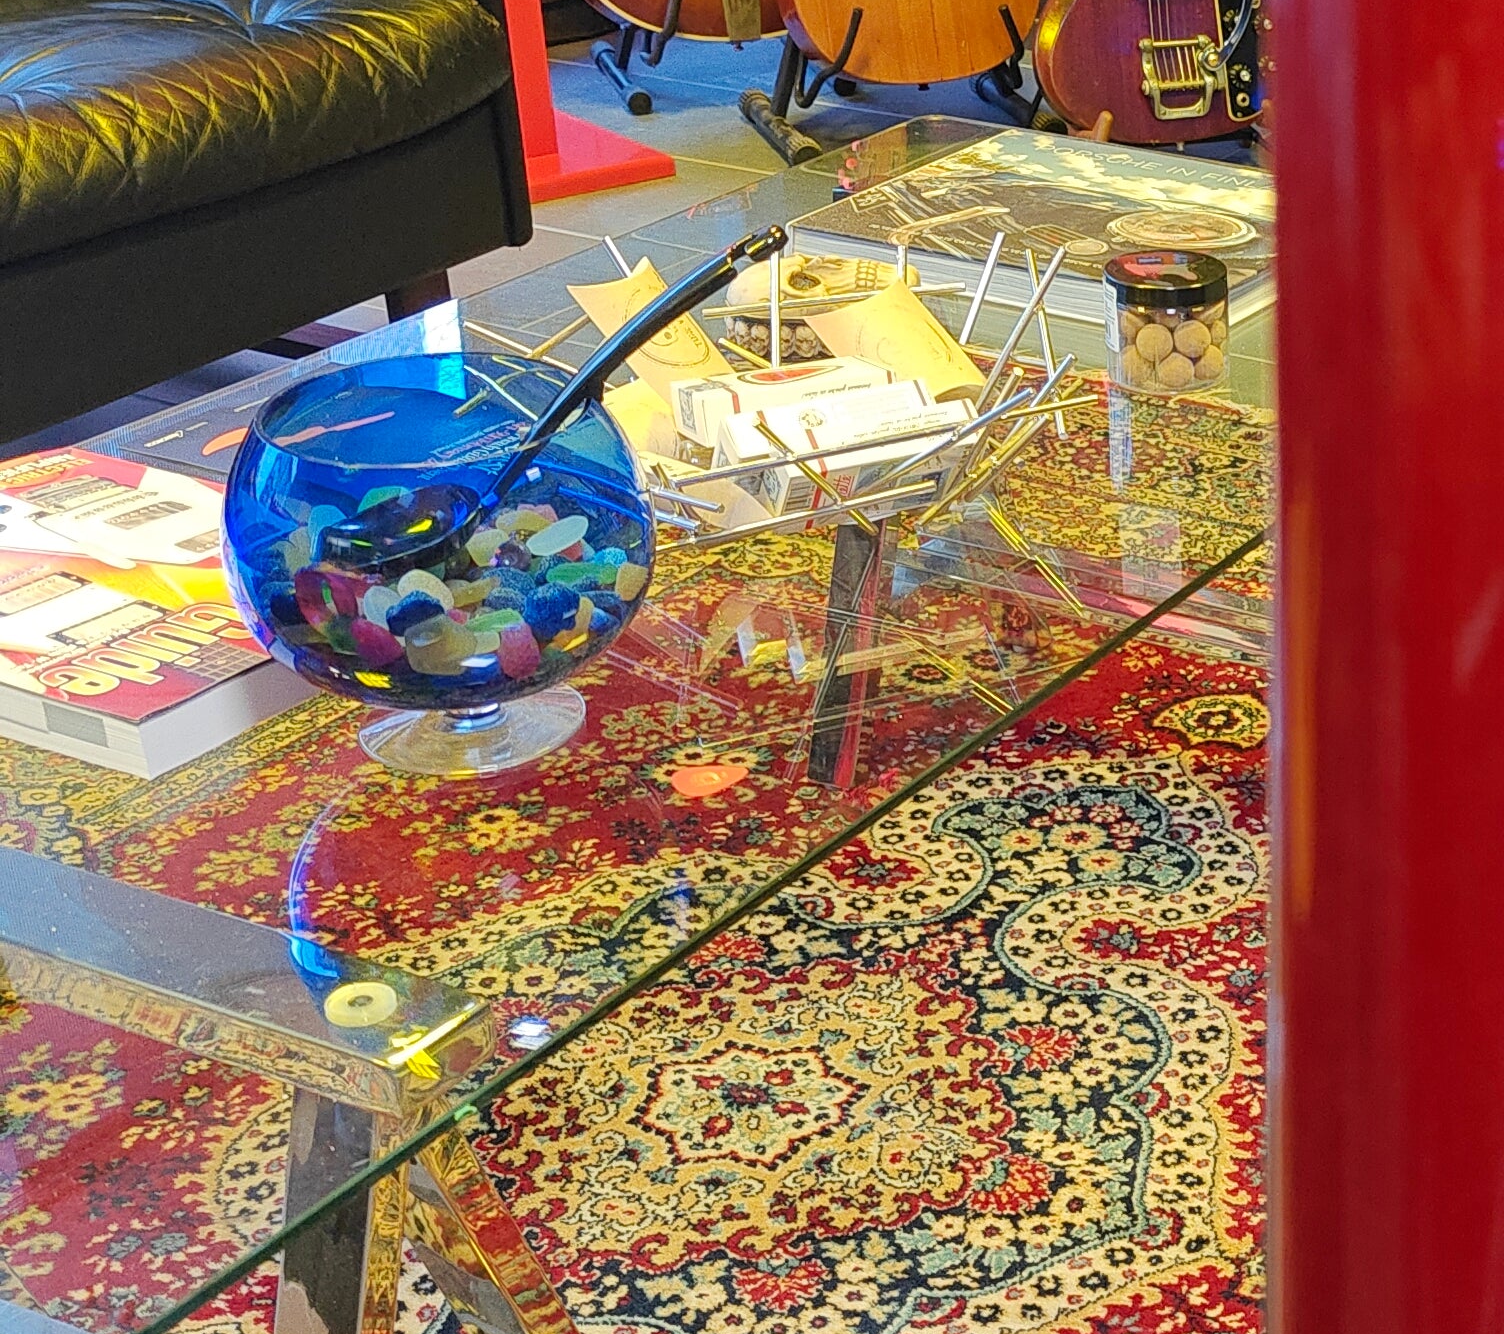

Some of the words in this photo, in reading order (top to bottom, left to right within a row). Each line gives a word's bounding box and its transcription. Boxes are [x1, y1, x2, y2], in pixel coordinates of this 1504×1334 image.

[1034, 144, 1162, 170] PORSCHE
[1166, 166, 1197, 178] IN
[39, 602, 253, 696] Guide
